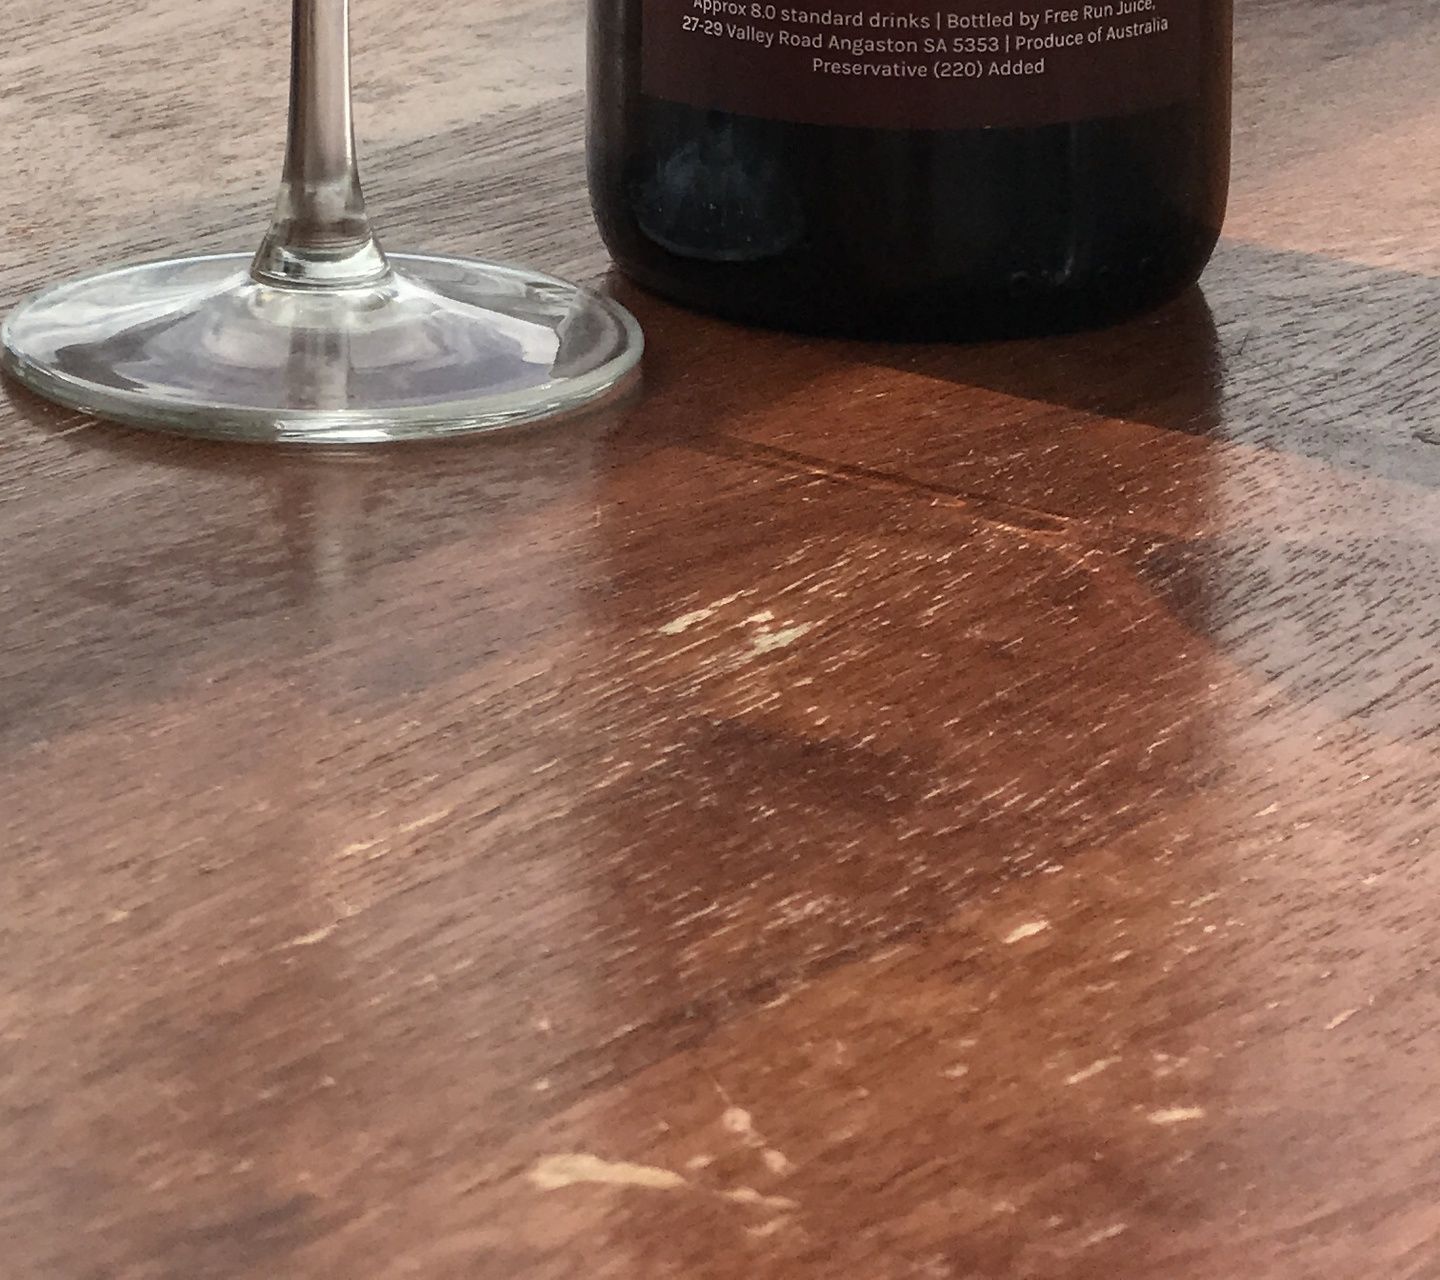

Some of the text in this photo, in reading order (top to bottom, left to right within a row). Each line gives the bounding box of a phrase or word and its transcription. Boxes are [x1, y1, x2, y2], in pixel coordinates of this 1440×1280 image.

[750, 2, 776, 20] 8.0
[780, 8, 863, 27] standard
[868, 11, 931, 29] drinks
[946, 11, 1014, 29] Bottled
[1019, 10, 1040, 31] by
[1044, 8, 1079, 25] Free
[1083, 4, 1114, 21] Run
[681, 14, 724, 37] 27-29
[725, 22, 775, 49] Valley
[778, 30, 823, 49] Road
[828, 34, 918, 57] Angaston
[923, 37, 948, 54] SA
[952, 36, 1000, 53] 5353
[1015, 32, 1084, 51] Produce
[1087, 25, 1103, 44] of
[1105, 16, 1169, 41] Australia
[812, 57, 1045, 79] Preservative (220) Added
